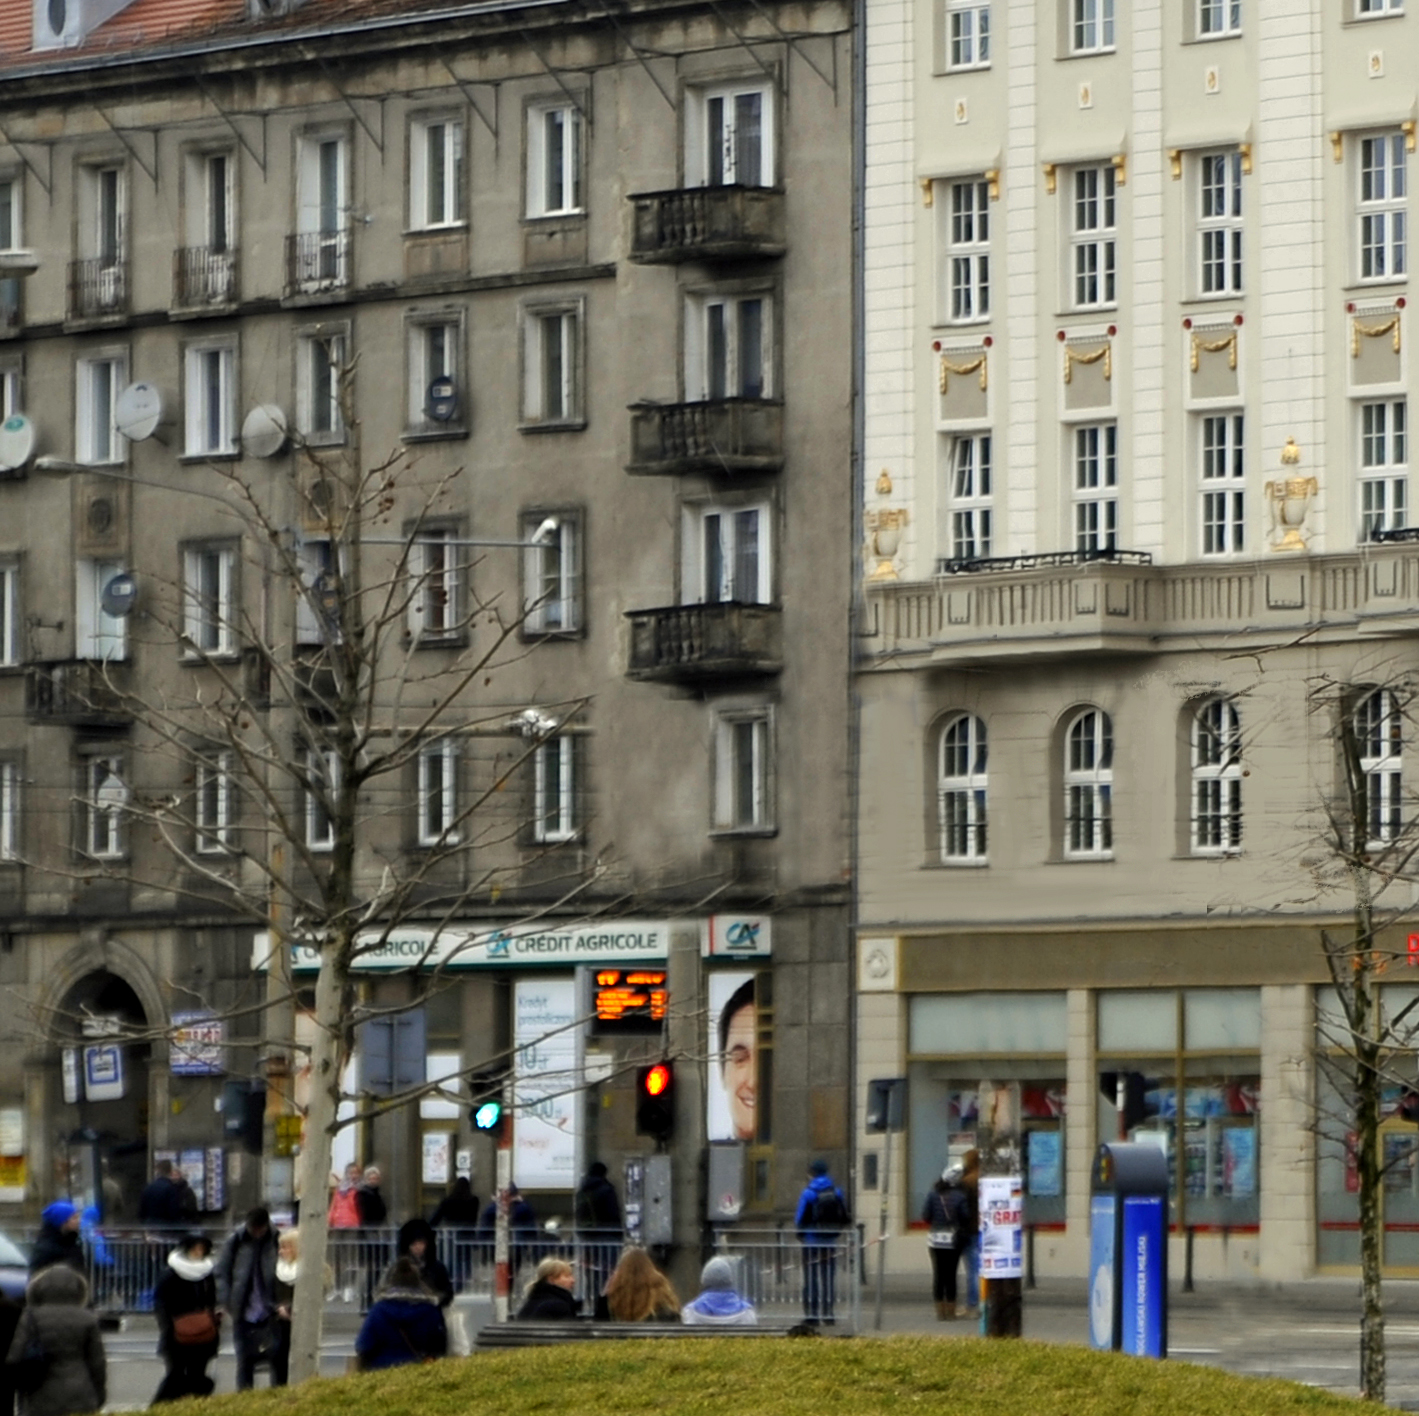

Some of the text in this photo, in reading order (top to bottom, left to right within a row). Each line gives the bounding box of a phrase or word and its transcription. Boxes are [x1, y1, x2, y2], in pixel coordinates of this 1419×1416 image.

[515, 935, 573, 952] CRÉDIT
[575, 933, 658, 951] AGRICOLE
[1137, 1236, 1147, 1271] MIEJSKI
[1137, 1272, 1147, 1304] ROWER
